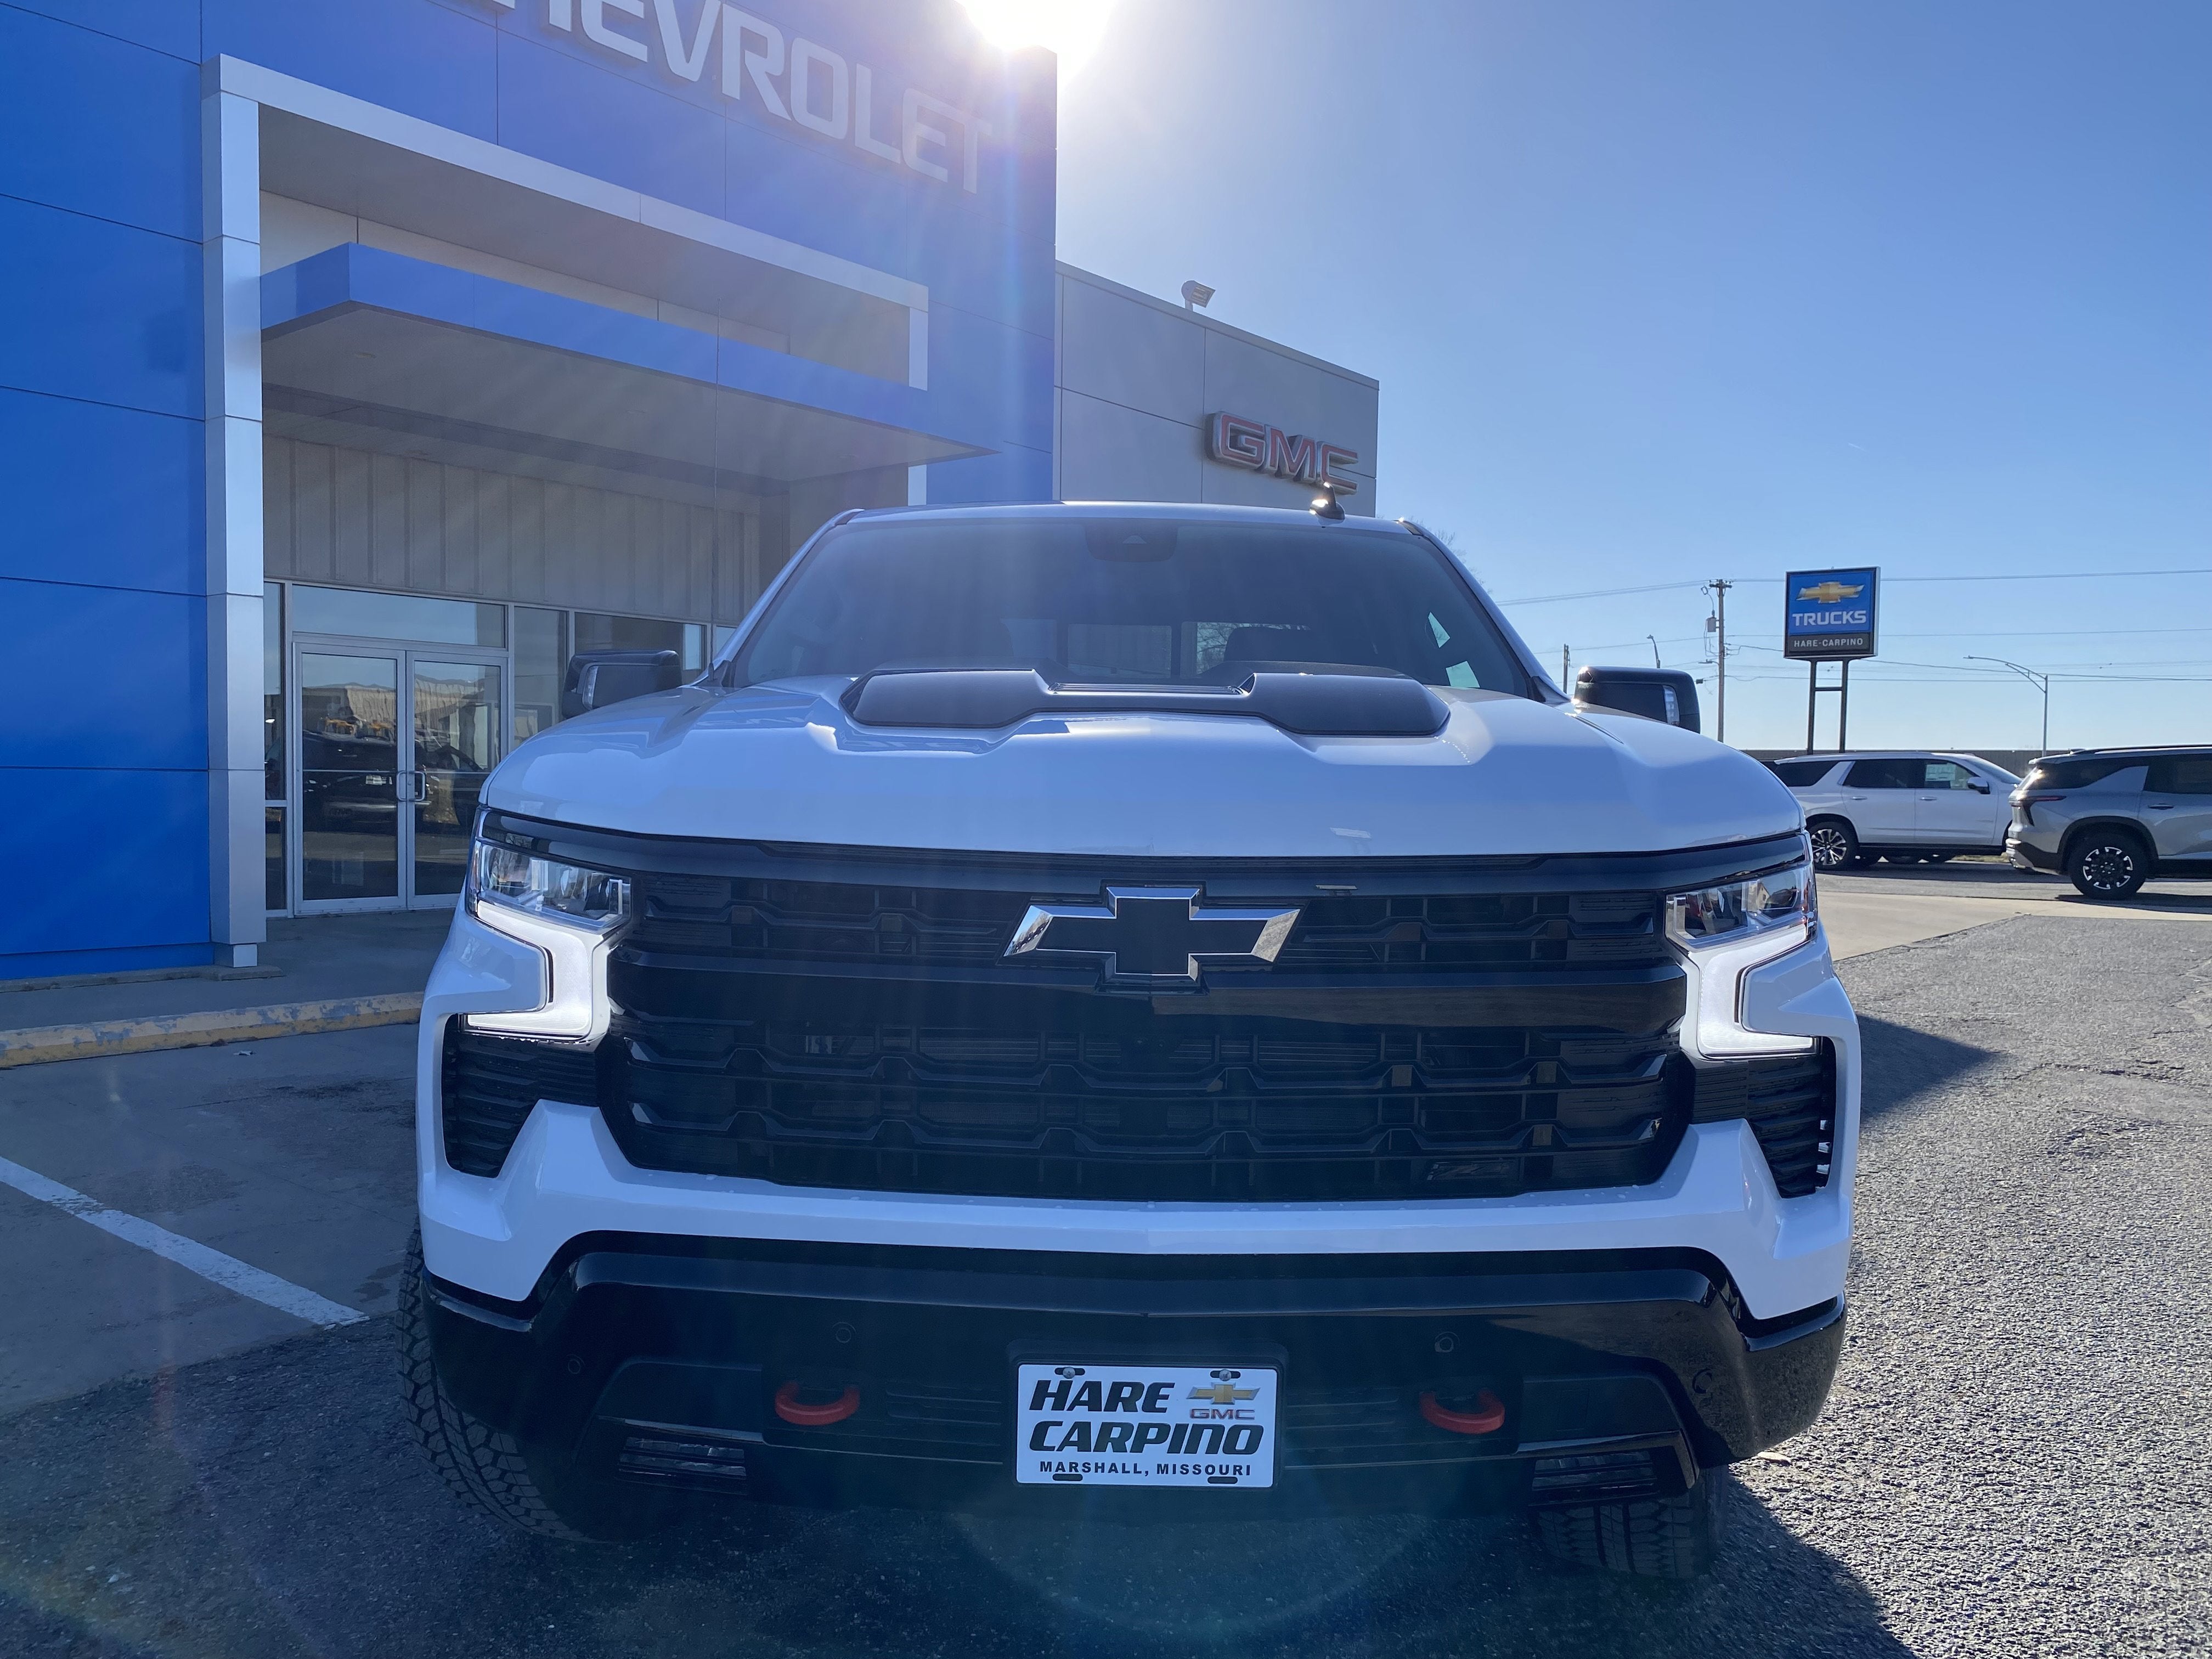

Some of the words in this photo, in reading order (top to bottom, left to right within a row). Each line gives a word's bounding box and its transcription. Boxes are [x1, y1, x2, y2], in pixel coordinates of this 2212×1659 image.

[492, 0, 993, 194] EVROLET
[1211, 411, 1359, 495] GMC
[1792, 611, 1866, 626] TRUCKS
[1793, 637, 1864, 647] HARE-CARPINO
[1029, 1380, 1176, 1413] HARE
[1189, 1408, 1256, 1420] GMC
[1029, 1421, 1264, 1455] CARPINO
[1040, 1461, 1149, 1476] MARSHALL,
[1156, 1463, 1251, 1476] MISSOURI
